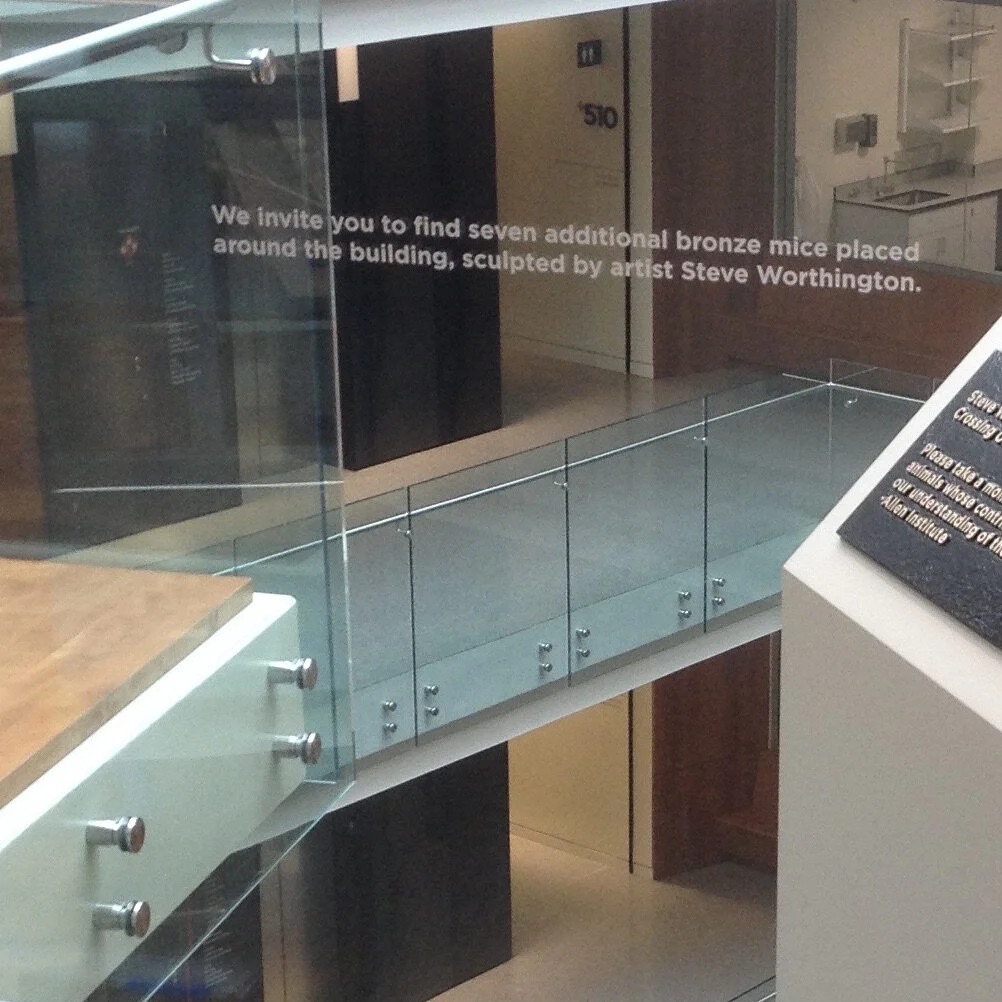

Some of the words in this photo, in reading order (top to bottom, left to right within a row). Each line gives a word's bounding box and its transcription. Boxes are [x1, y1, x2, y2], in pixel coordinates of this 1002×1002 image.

[584, 103, 618, 129] 510
[211, 204, 250, 225] We
[257, 207, 323, 229] invite
[330, 215, 374, 234] you
[381, 215, 406, 234] to
[413, 215, 460, 238] find
[468, 223, 537, 242] seven
[544, 224, 667, 249] additional
[676, 230, 760, 254] bronze
[769, 236, 828, 257] mice
[836, 239, 920, 261] placed
[213, 238, 296, 257] around
[304, 240, 342, 260] the
[350, 242, 454, 270] building,
[462, 250, 565, 274] sculpted
[573, 254, 602, 278] by
[610, 259, 673, 279] artist
[681, 261, 748, 283] Steve
[757, 265, 922, 293] Worthington.
[954, 407, 998, 440] Crossing
[967, 390, 998, 414] Steve
[906, 461, 945, 489] animals
[942, 483, 976, 508] whose
[920, 443, 954, 469] Please
[952, 462, 976, 483] take
[973, 477, 984, 488] a
[892, 479, 913, 494] our
[908, 489, 980, 539] understanding
[976, 532, 995, 545] of
[906, 509, 949, 544] Institute
